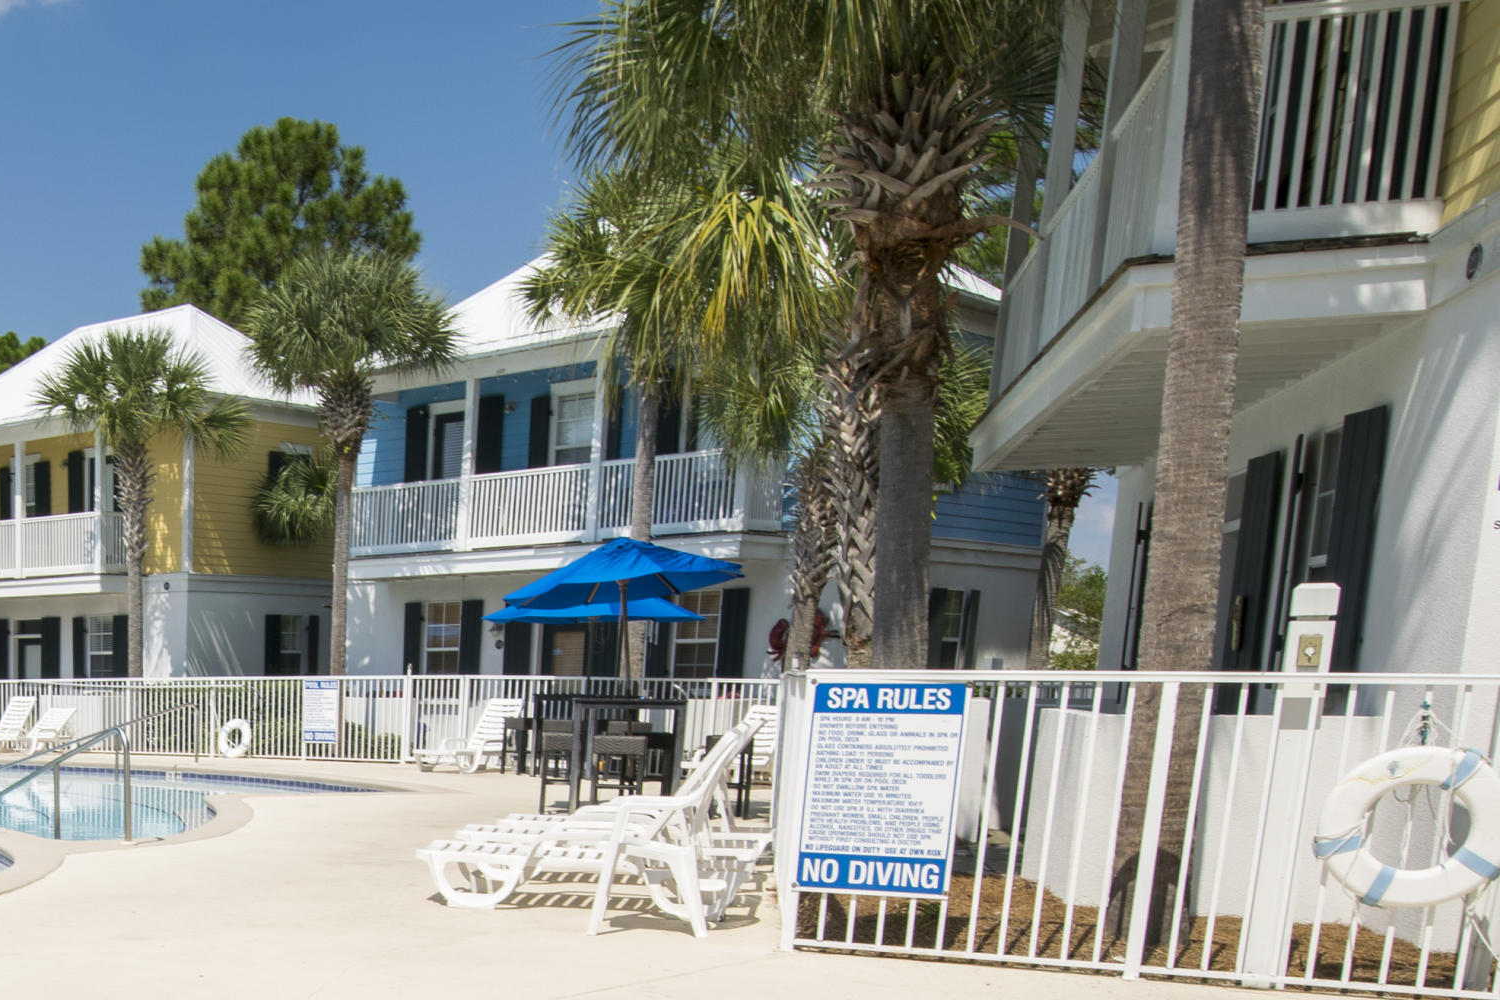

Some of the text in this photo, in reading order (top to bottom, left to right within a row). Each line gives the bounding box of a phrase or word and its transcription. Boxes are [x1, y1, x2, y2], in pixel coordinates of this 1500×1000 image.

[827, 687, 952, 710] SPA RULES
[815, 844, 850, 852] LIFEGUARD
[802, 858, 939, 889] NO DIVING
